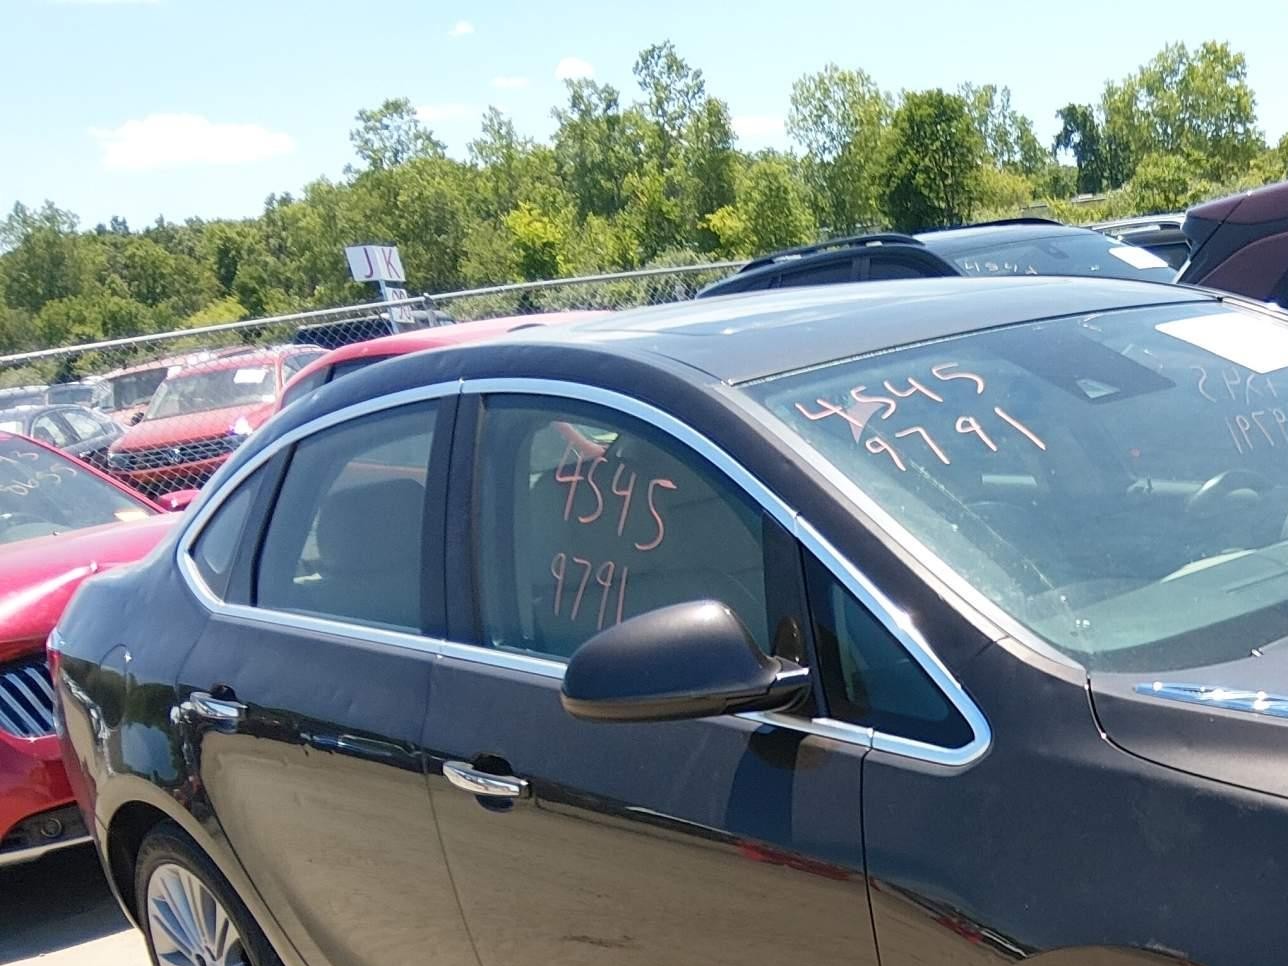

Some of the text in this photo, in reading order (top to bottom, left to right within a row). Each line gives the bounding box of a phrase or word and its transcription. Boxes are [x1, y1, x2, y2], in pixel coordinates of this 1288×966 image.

[794, 362, 985, 428] 4545
[865, 406, 1047, 472] 9791
[555, 444, 678, 551] 4545
[551, 552, 629, 631] 9791
